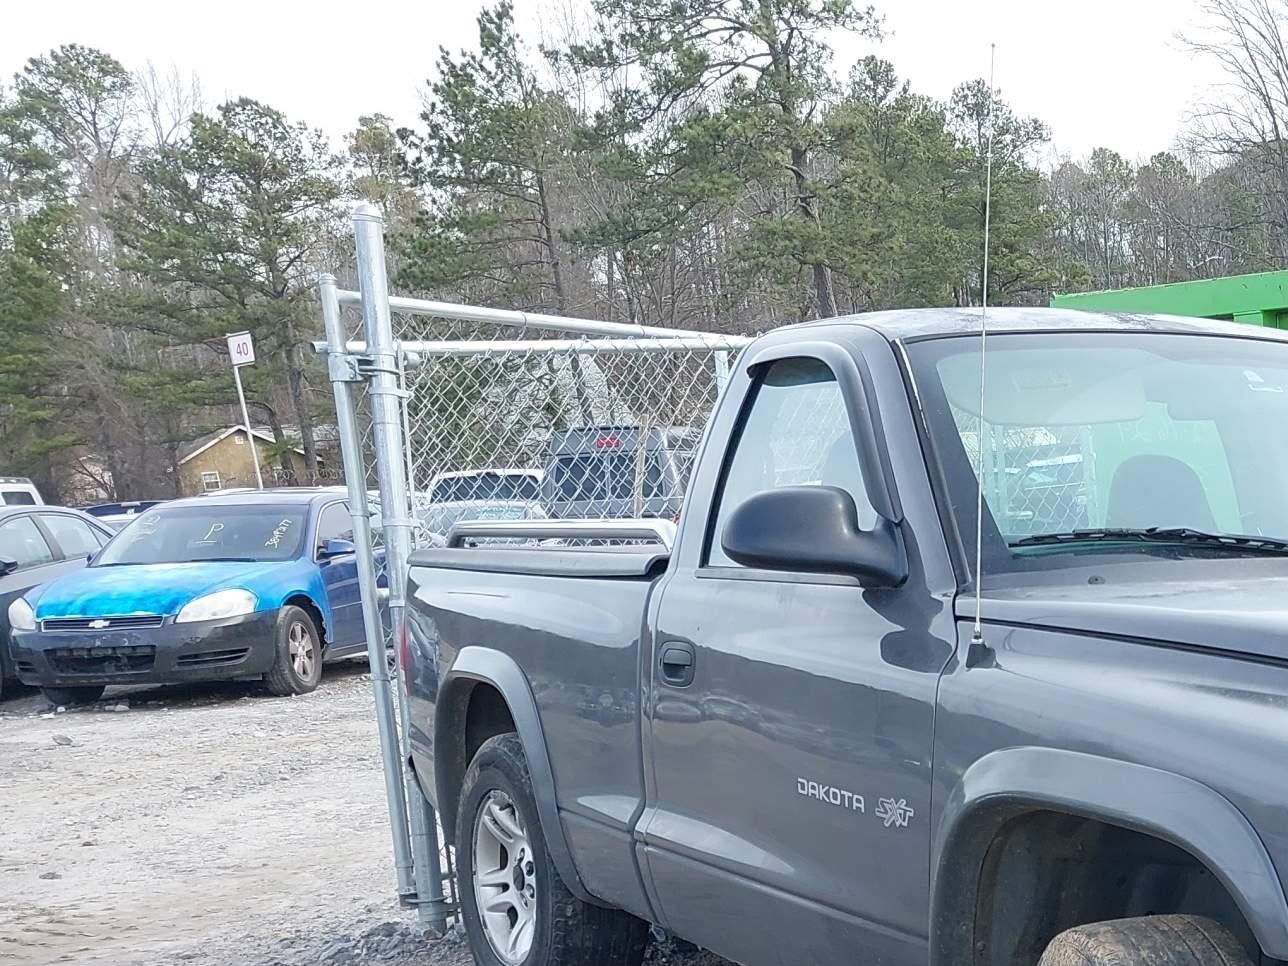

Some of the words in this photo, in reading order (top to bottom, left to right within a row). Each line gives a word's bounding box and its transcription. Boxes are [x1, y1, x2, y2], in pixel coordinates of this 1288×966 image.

[236, 341, 249, 357] 40
[797, 777, 865, 813] DAKOTA
[875, 797, 914, 828] SXT
